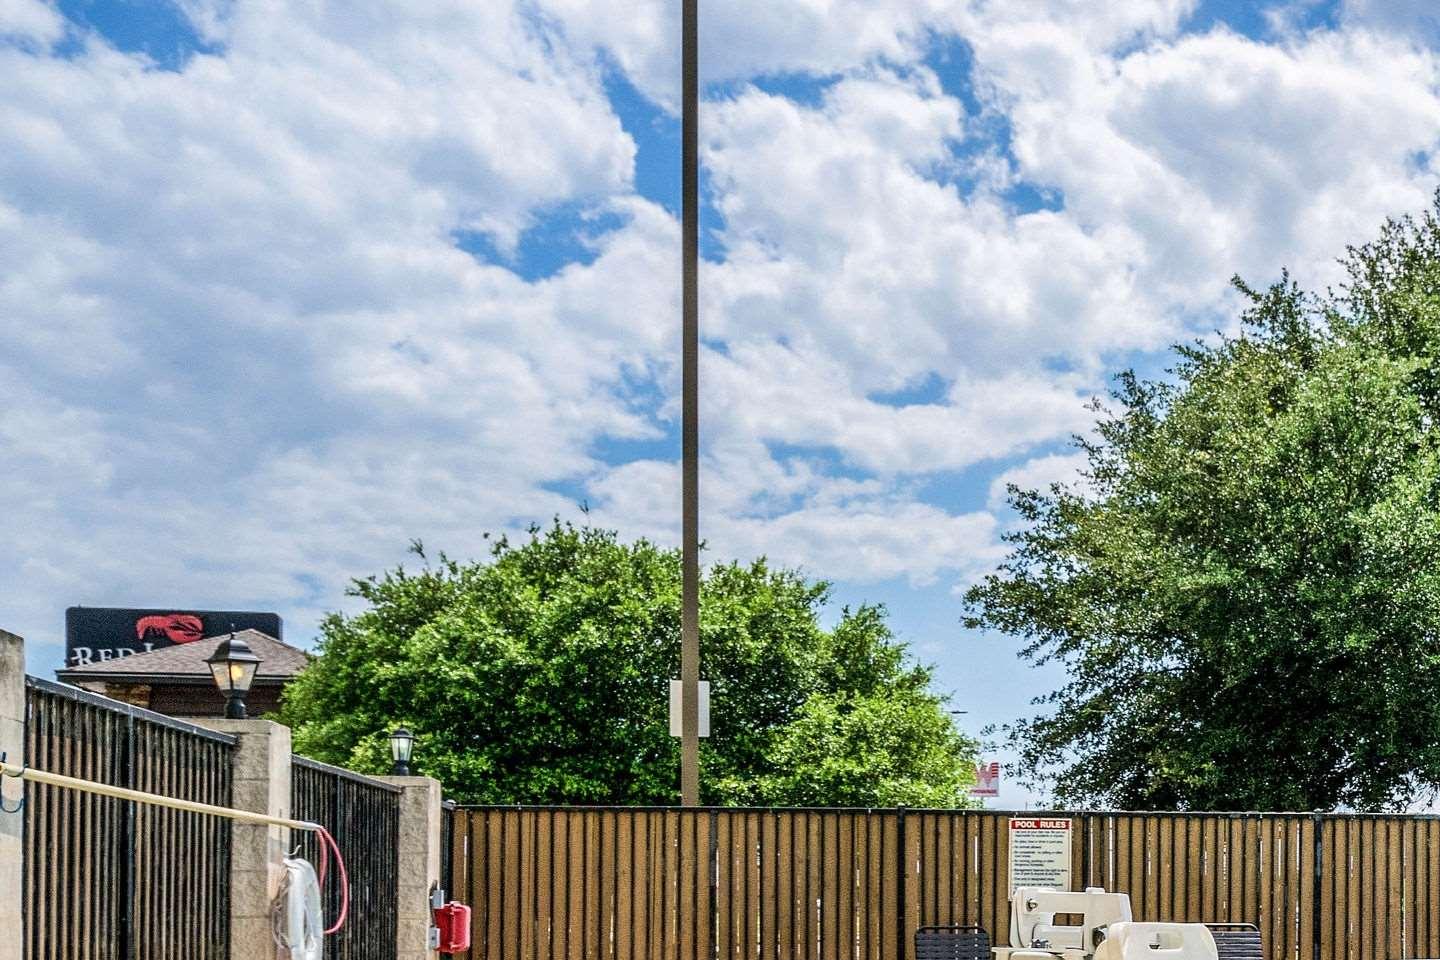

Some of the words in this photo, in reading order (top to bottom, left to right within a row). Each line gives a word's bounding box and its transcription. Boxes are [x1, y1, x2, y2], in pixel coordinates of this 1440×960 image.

[70, 647, 136, 666] RED
[1015, 821, 1038, 829] POOL
[1040, 821, 1067, 829] RULES
